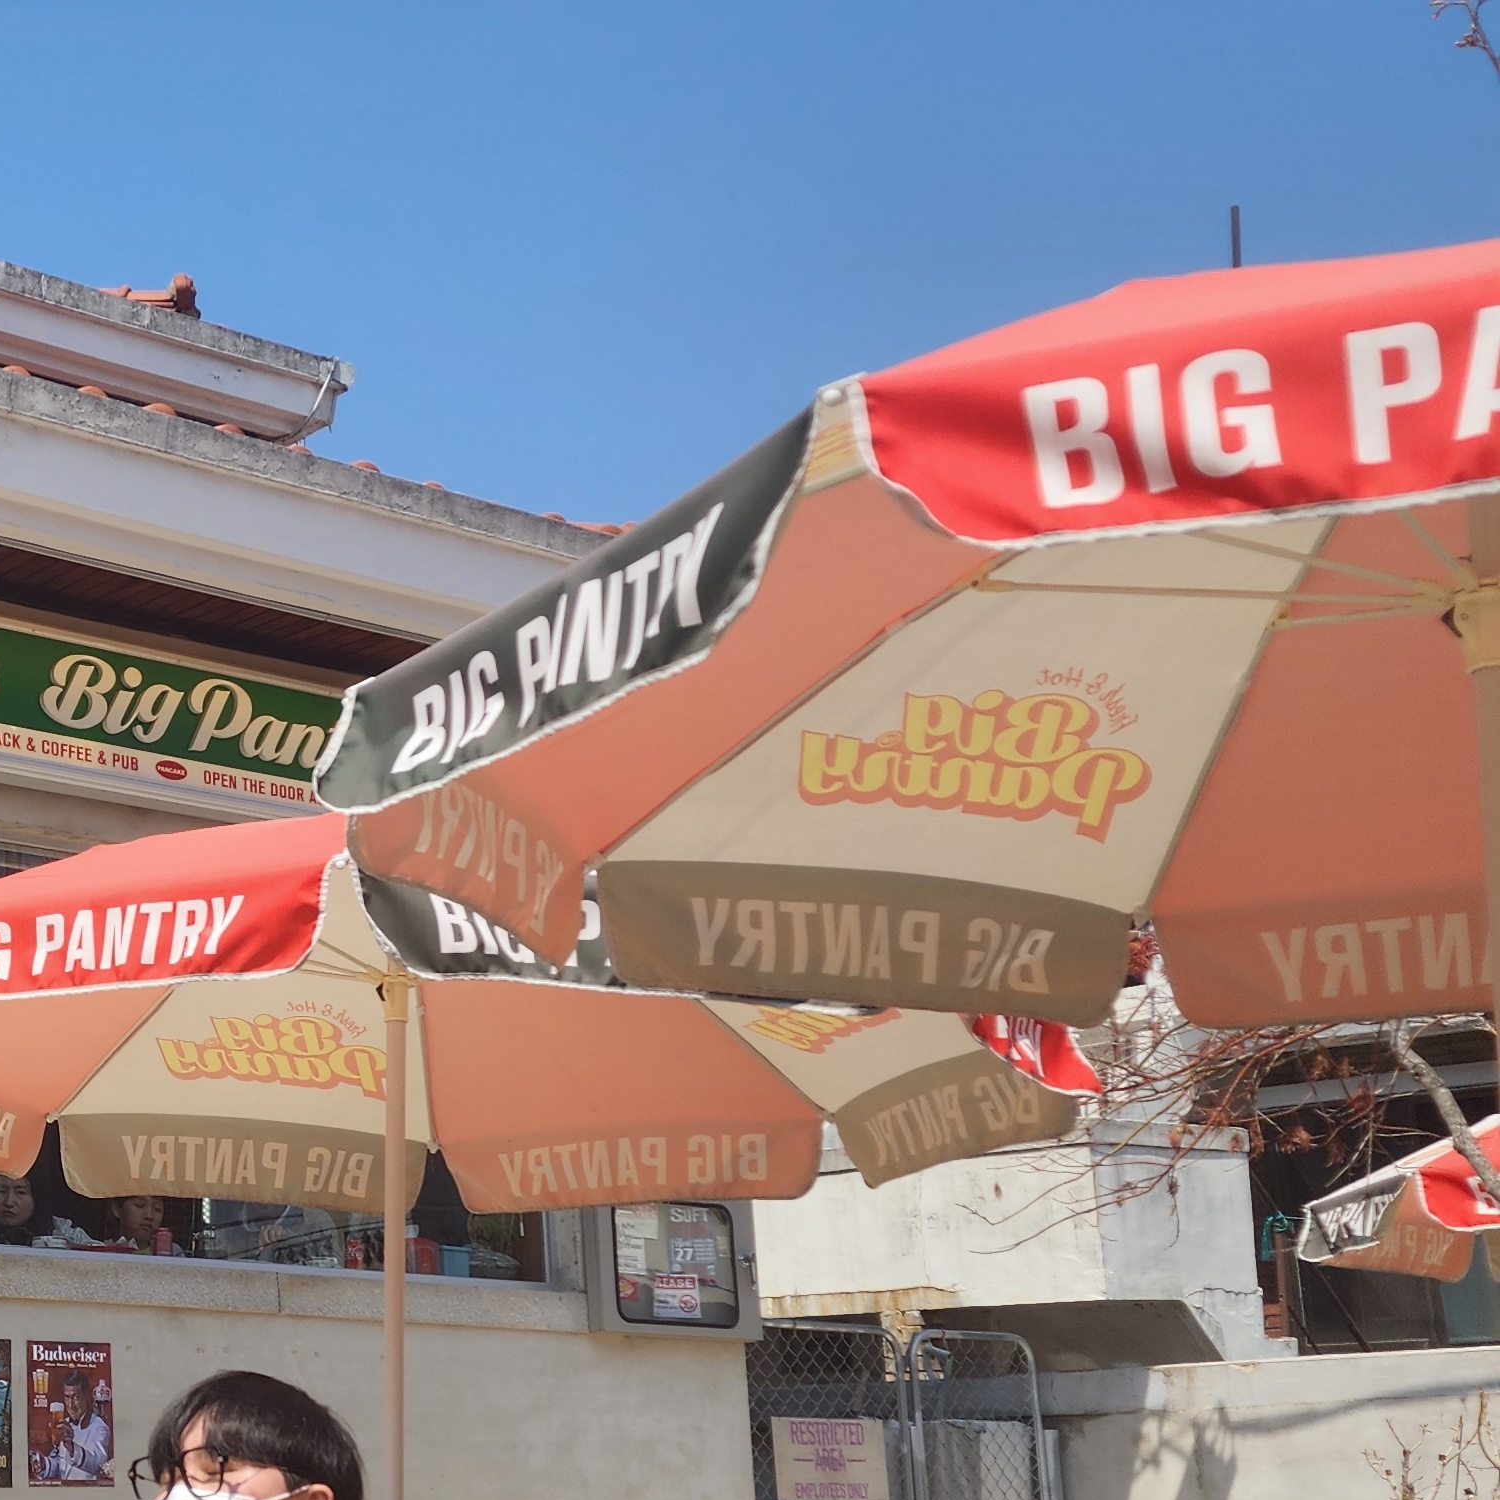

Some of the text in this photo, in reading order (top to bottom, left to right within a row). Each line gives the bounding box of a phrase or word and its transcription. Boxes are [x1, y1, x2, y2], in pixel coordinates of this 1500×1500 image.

[1024, 346, 1282, 508] BIG
[39, 654, 334, 769] Big Pan
[391, 649, 505, 774] BIG
[26, 737, 37, 752] &
[41, 740, 92, 763] COFFEE
[97, 750, 108, 765] &
[112, 753, 139, 772] PUB
[156, 764, 186, 777] PANCAKE
[203, 770, 237, 790] OPEN
[241, 778, 266, 795] THE
[270, 783, 305, 802] DOOR
[30, 894, 245, 976] PANTRY
[32, 1344, 107, 1363] Budweiser
[790, 1421, 865, 1446] RESTRICTED
[814, 1448, 847, 1472] AREA
[795, 1482, 869, 1499] EMPLOYEES ONLY
